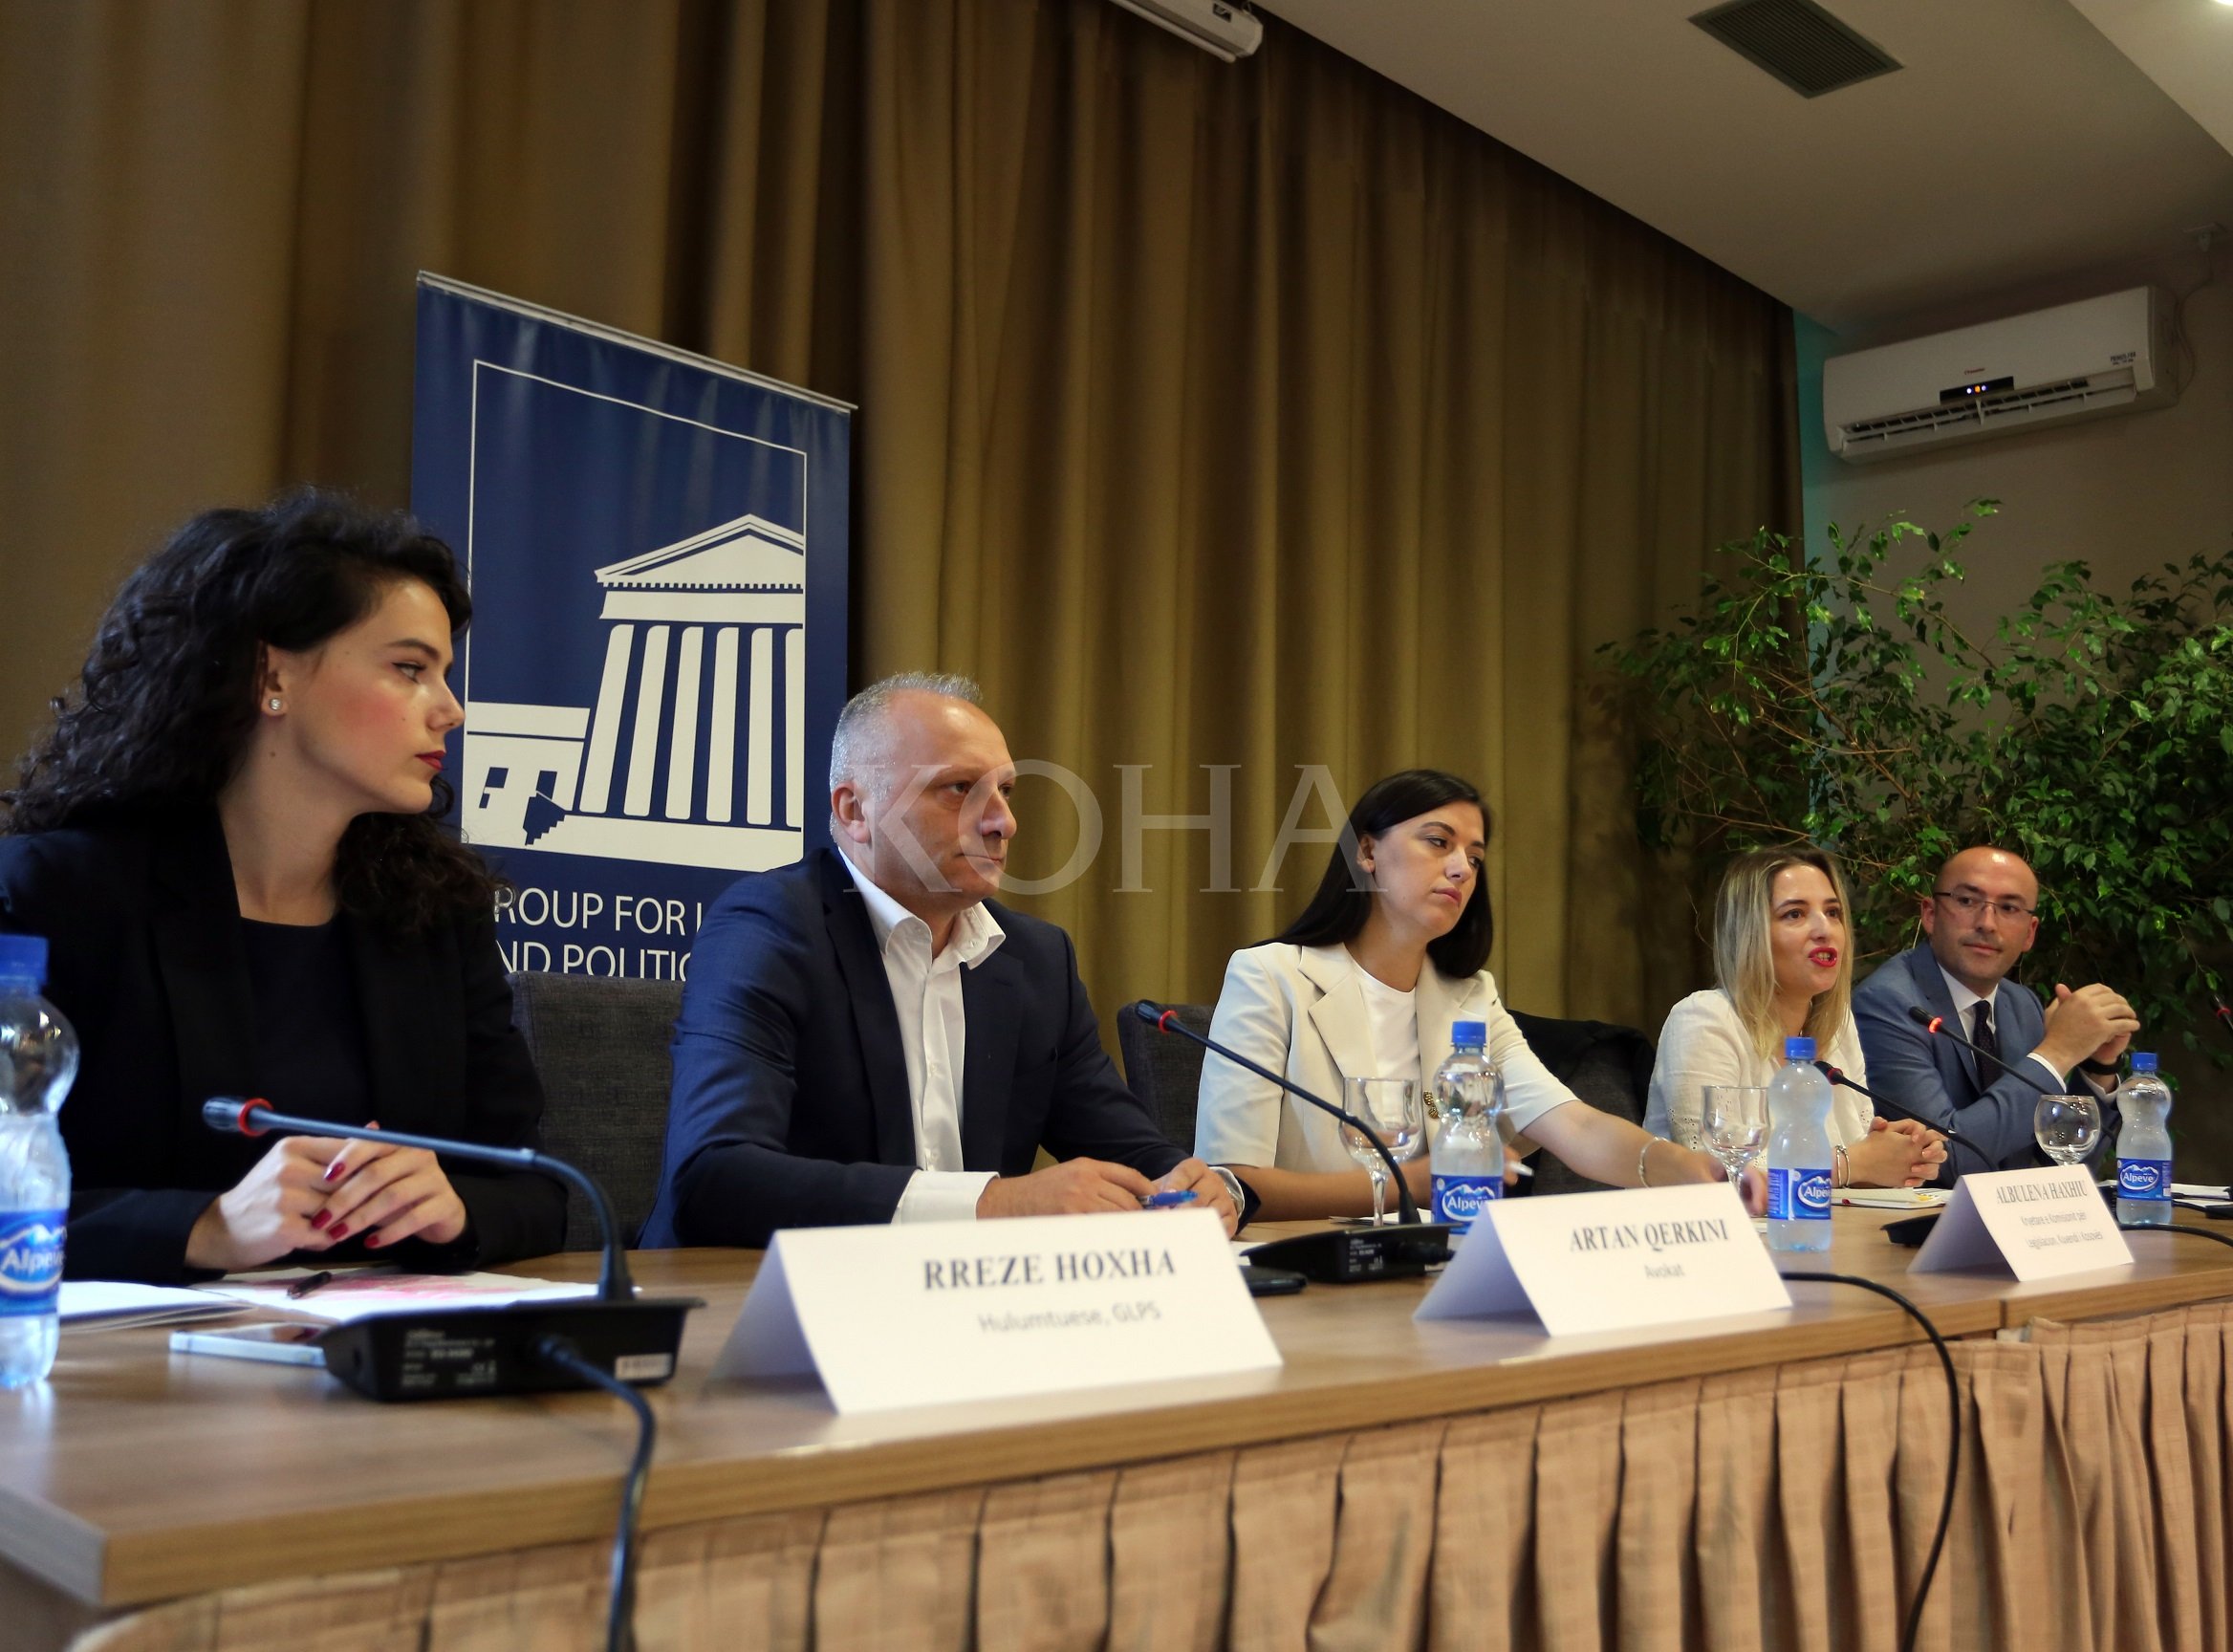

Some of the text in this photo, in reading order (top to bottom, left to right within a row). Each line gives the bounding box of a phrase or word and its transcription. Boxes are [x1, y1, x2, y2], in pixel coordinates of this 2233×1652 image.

[494, 886, 604, 930] ROUP
[615, 895, 686, 937] FOR
[495, 941, 552, 973] ND
[1996, 1180, 2088, 1204] ALBULENA HAXHIU
[2123, 1172, 2154, 1184] Alpeve
[1447, 1196, 1485, 1211] Alpev
[1570, 1219, 1728, 1251] ARTAN QERKINI
[924, 1249, 1176, 1290] RREZE HOXHA
[1112, 1300, 1162, 1322] GLPS
